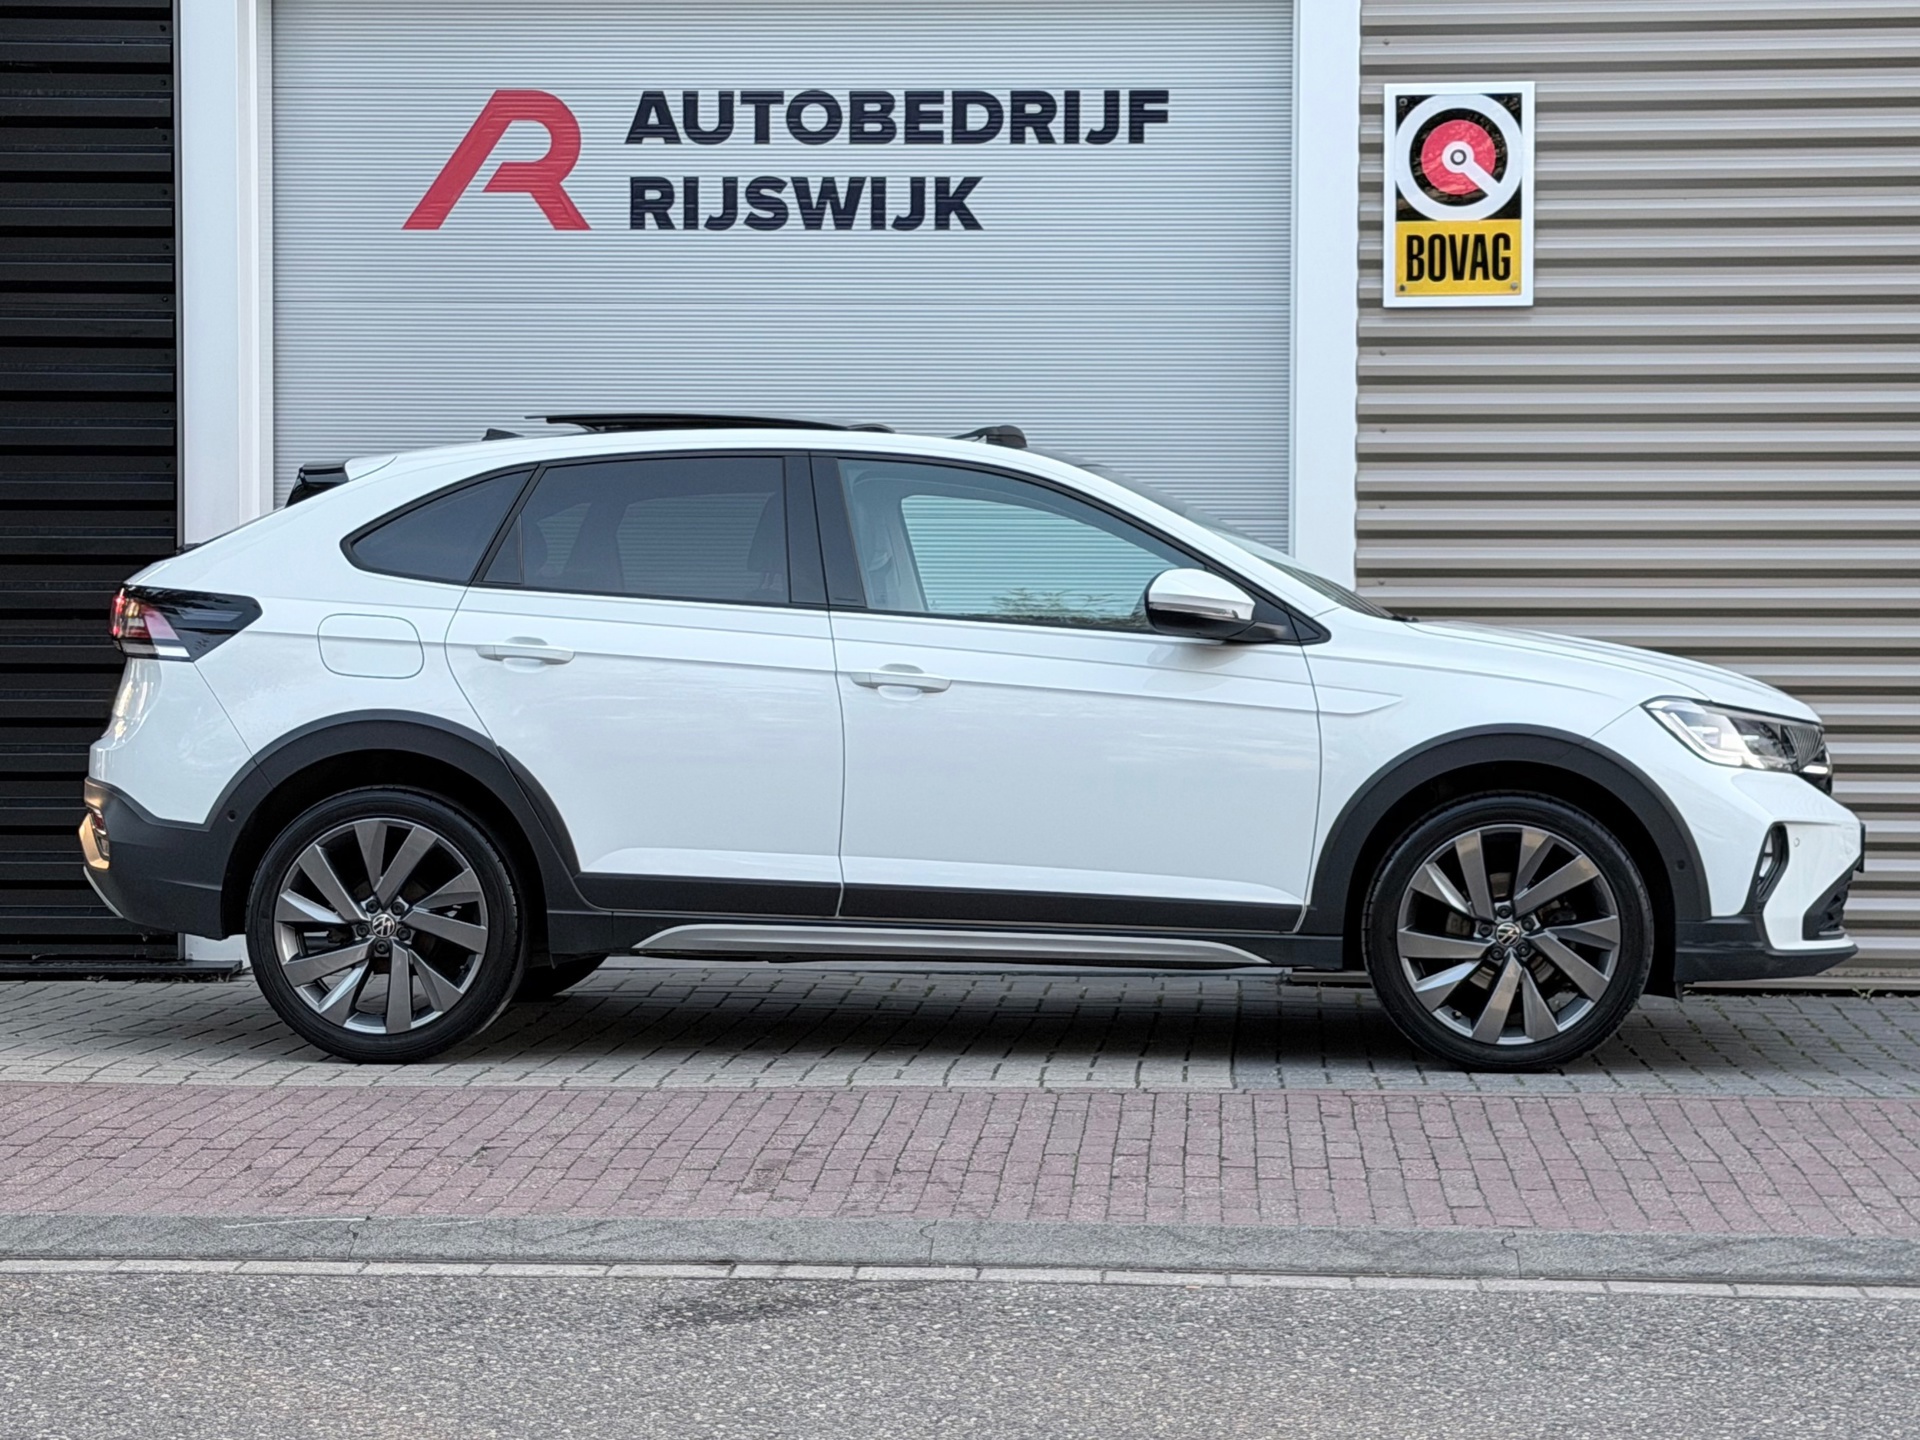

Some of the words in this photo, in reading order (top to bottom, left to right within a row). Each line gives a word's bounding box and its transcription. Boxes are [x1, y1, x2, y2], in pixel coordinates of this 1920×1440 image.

[625, 89, 1169, 146] AUTOBEDRIJF
[629, 175, 983, 231] RIJSWIJK
[1406, 232, 1511, 282] BOVAG
